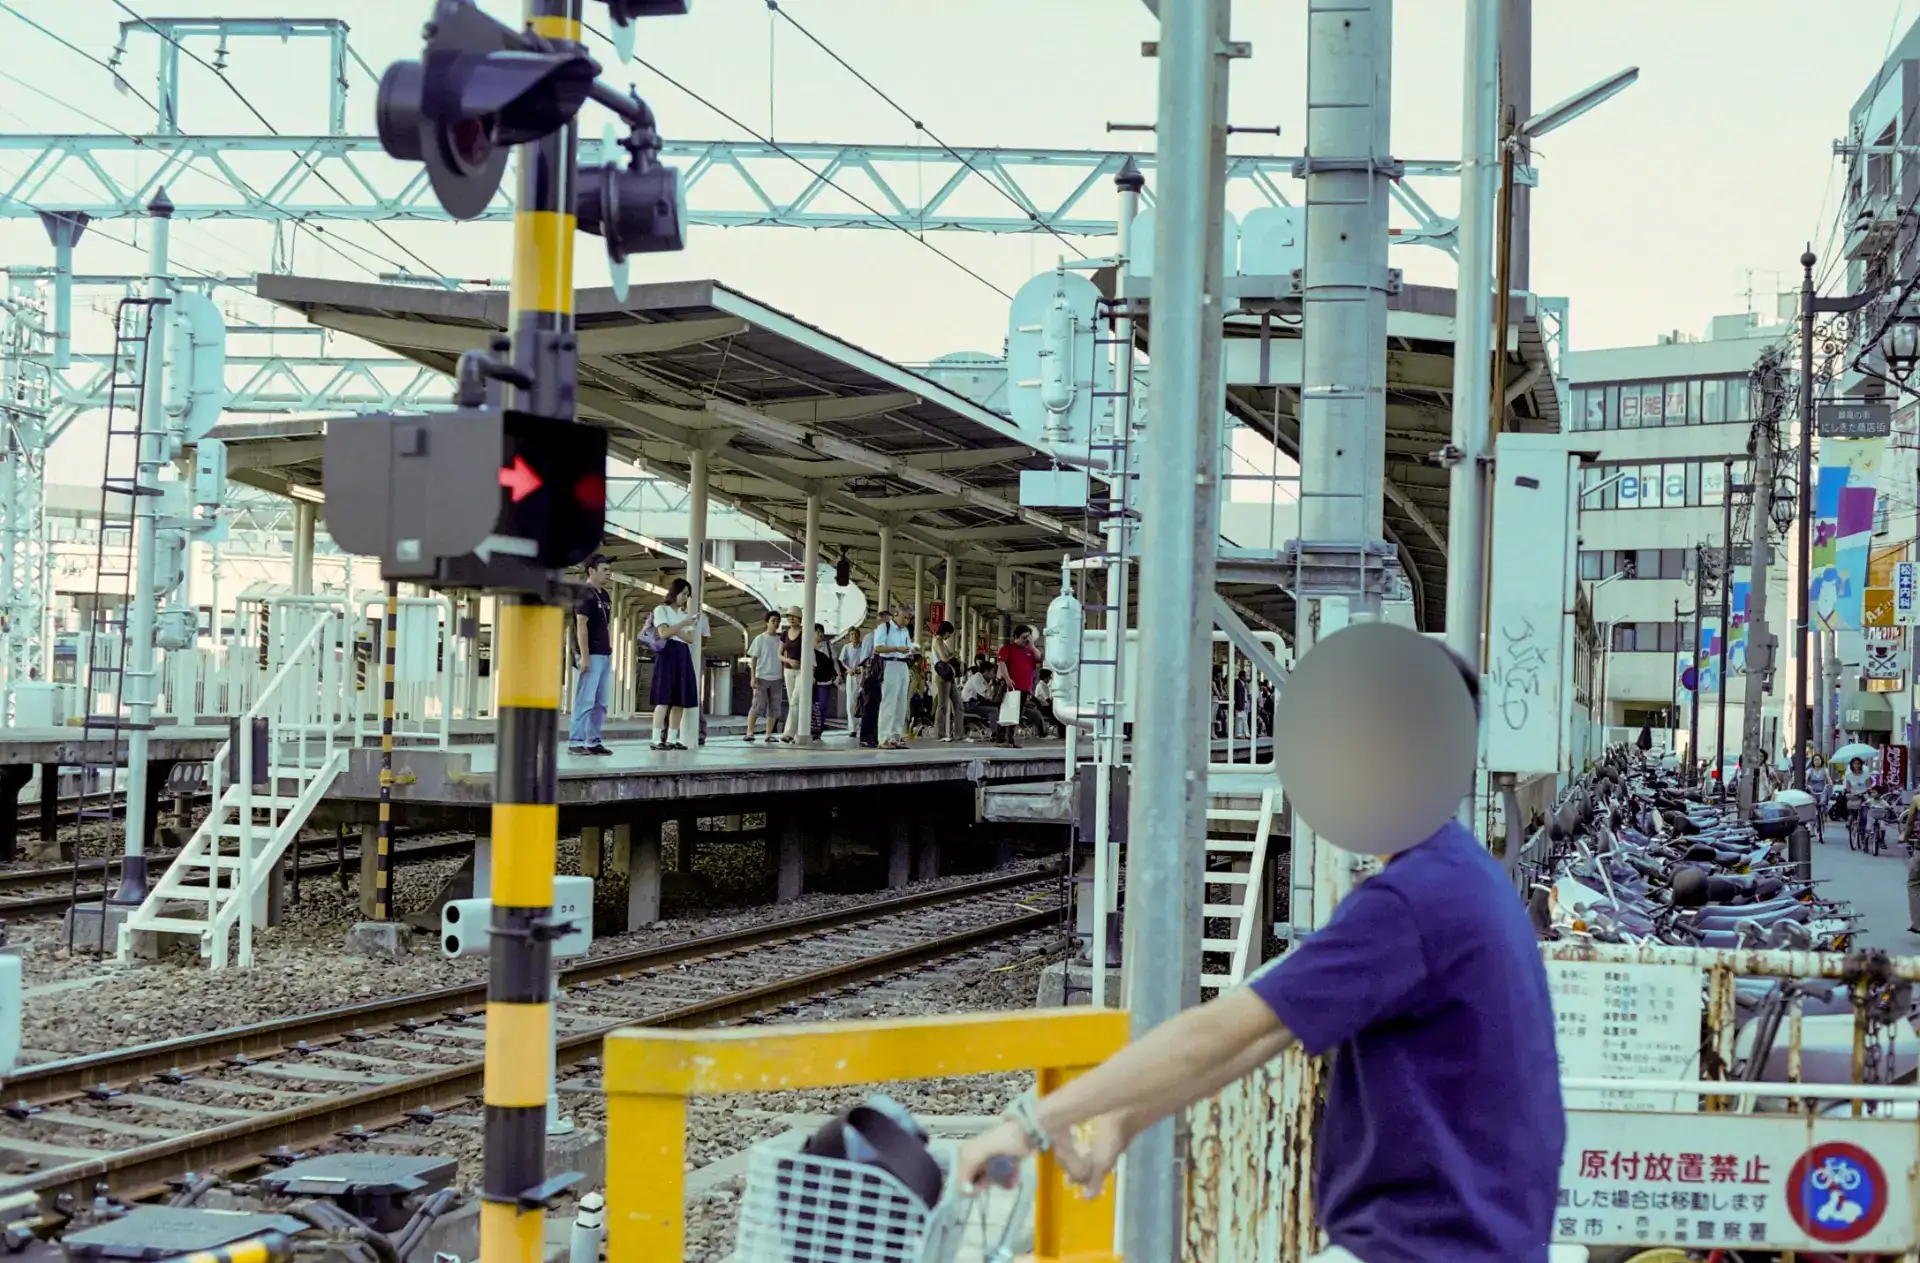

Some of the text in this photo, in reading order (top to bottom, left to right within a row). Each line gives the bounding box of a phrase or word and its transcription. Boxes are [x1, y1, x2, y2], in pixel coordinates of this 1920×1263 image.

[1821, 422, 1886, 433] にしきた商店街
[1899, 565, 1912, 609] 松本内科
[1579, 1150, 1771, 1184] 原付放置禁止
